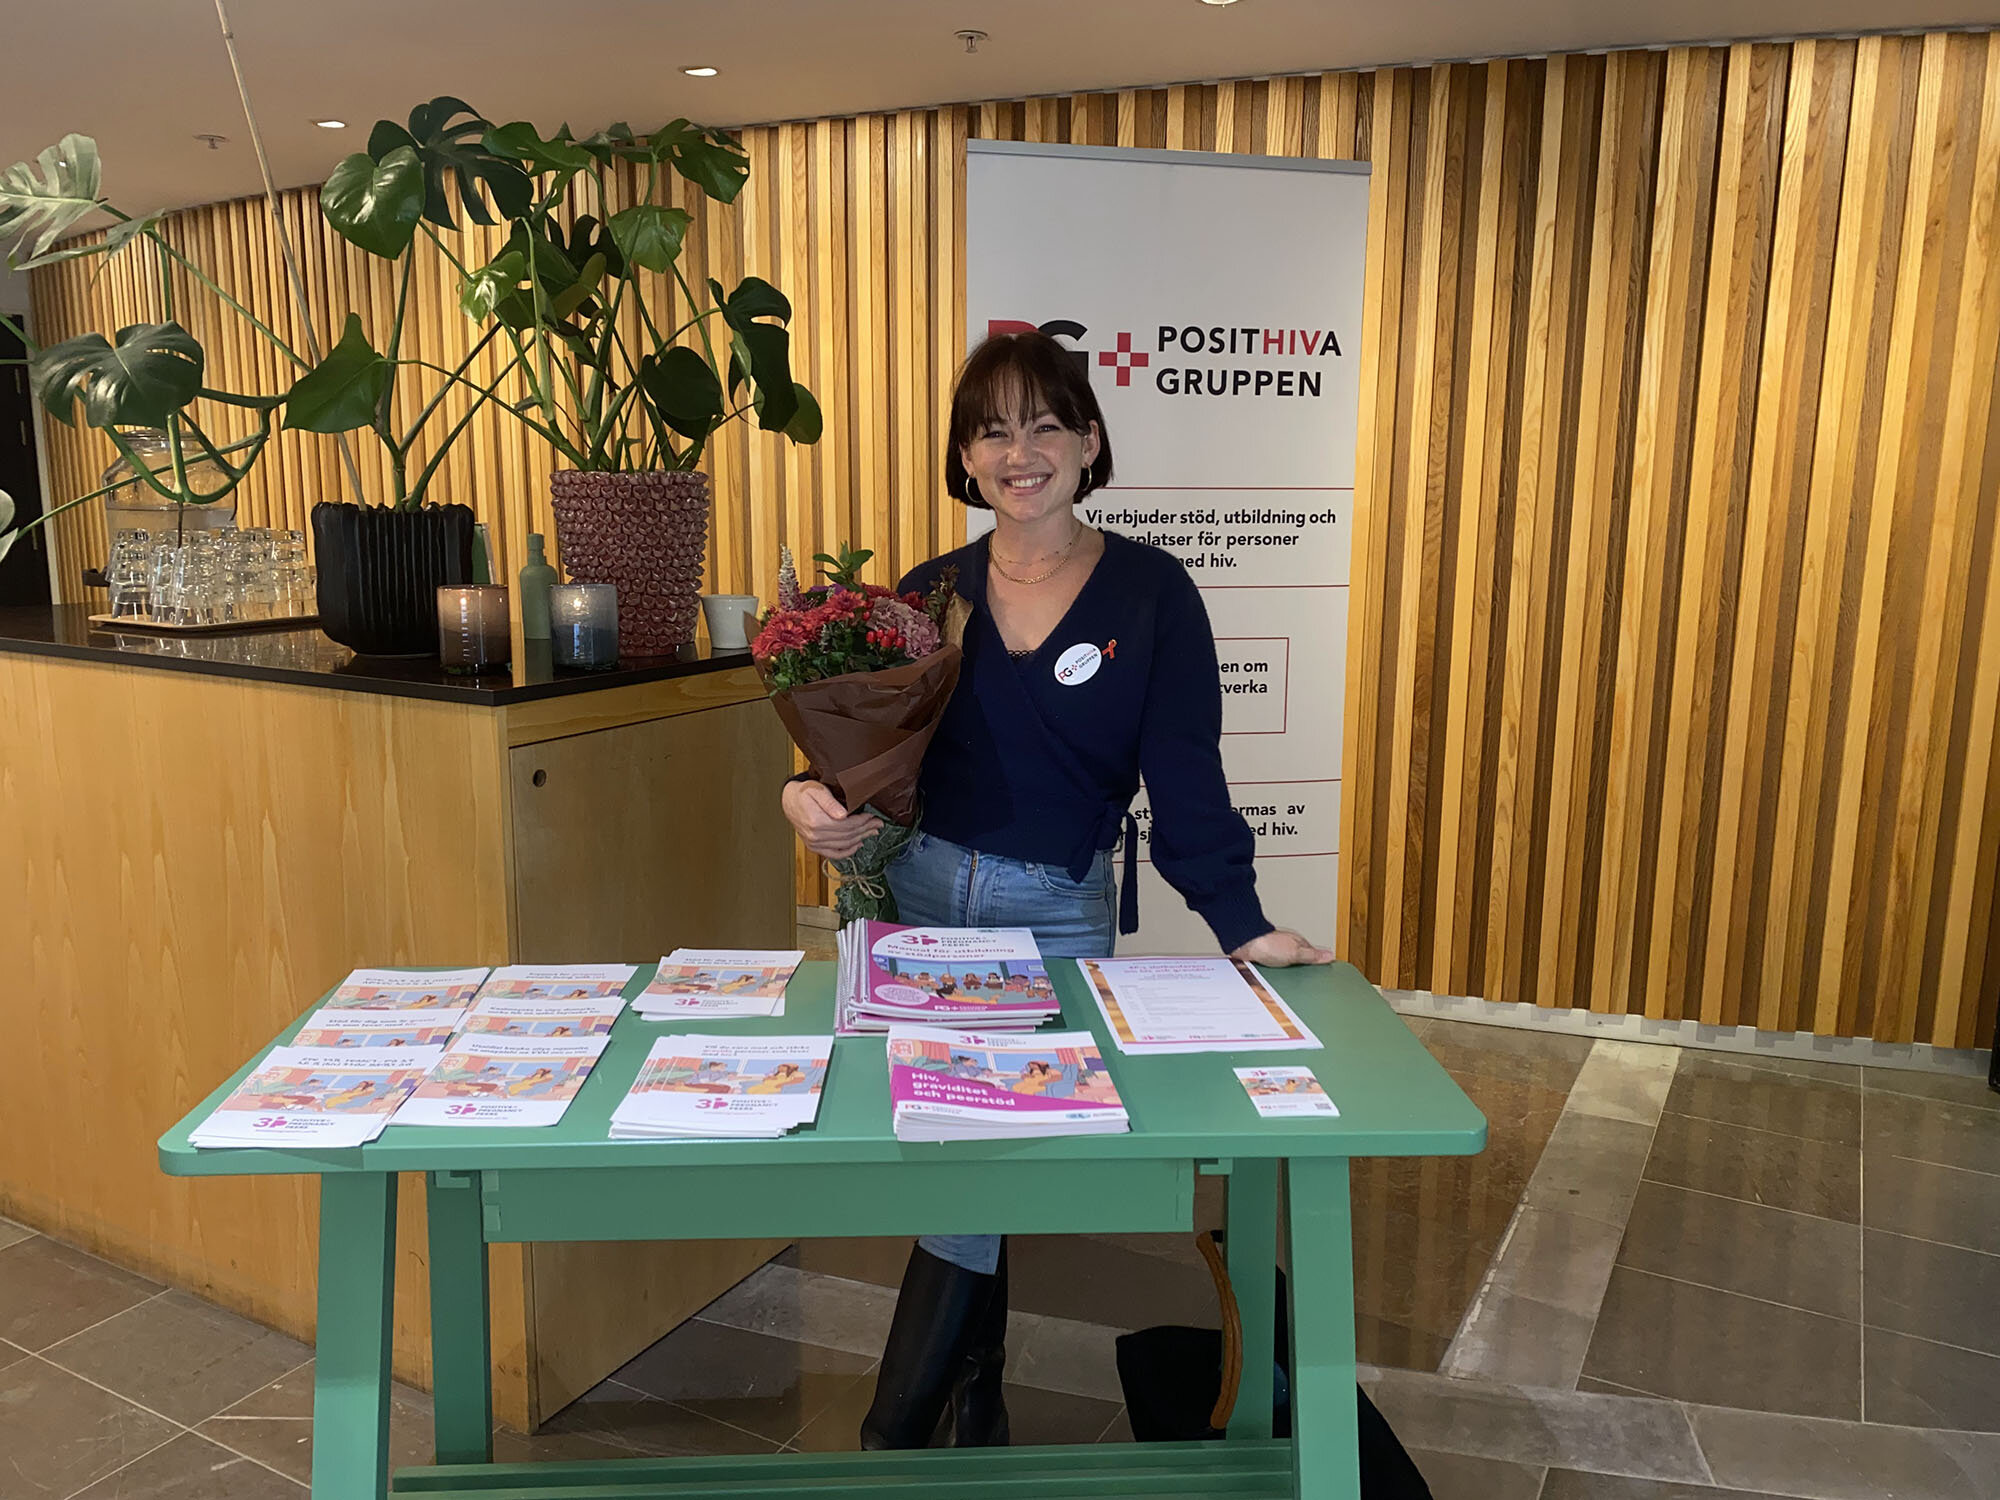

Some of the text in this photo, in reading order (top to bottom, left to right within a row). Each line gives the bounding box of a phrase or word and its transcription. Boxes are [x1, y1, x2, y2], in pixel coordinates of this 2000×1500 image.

[1158, 326, 1342, 357] POSITHIVA
[1156, 367, 1322, 397] GRUPPEN
[1085, 509, 1336, 528] Vi erbjuder stöd, utbildning och
[1198, 531, 1222, 546] för
[1226, 534, 1299, 550] personer
[1178, 553, 1237, 568] ed hiv.
[1243, 662, 1268, 673] om
[1219, 679, 1268, 694] verka
[1287, 804, 1306, 815] av
[1250, 821, 1298, 836] ed hiv.
[887, 944, 930, 952] Manual
[911, 1071, 939, 1081] Hiv,
[912, 1081, 988, 1095] graviditet
[945, 1092, 1015, 1105] peerstöd
